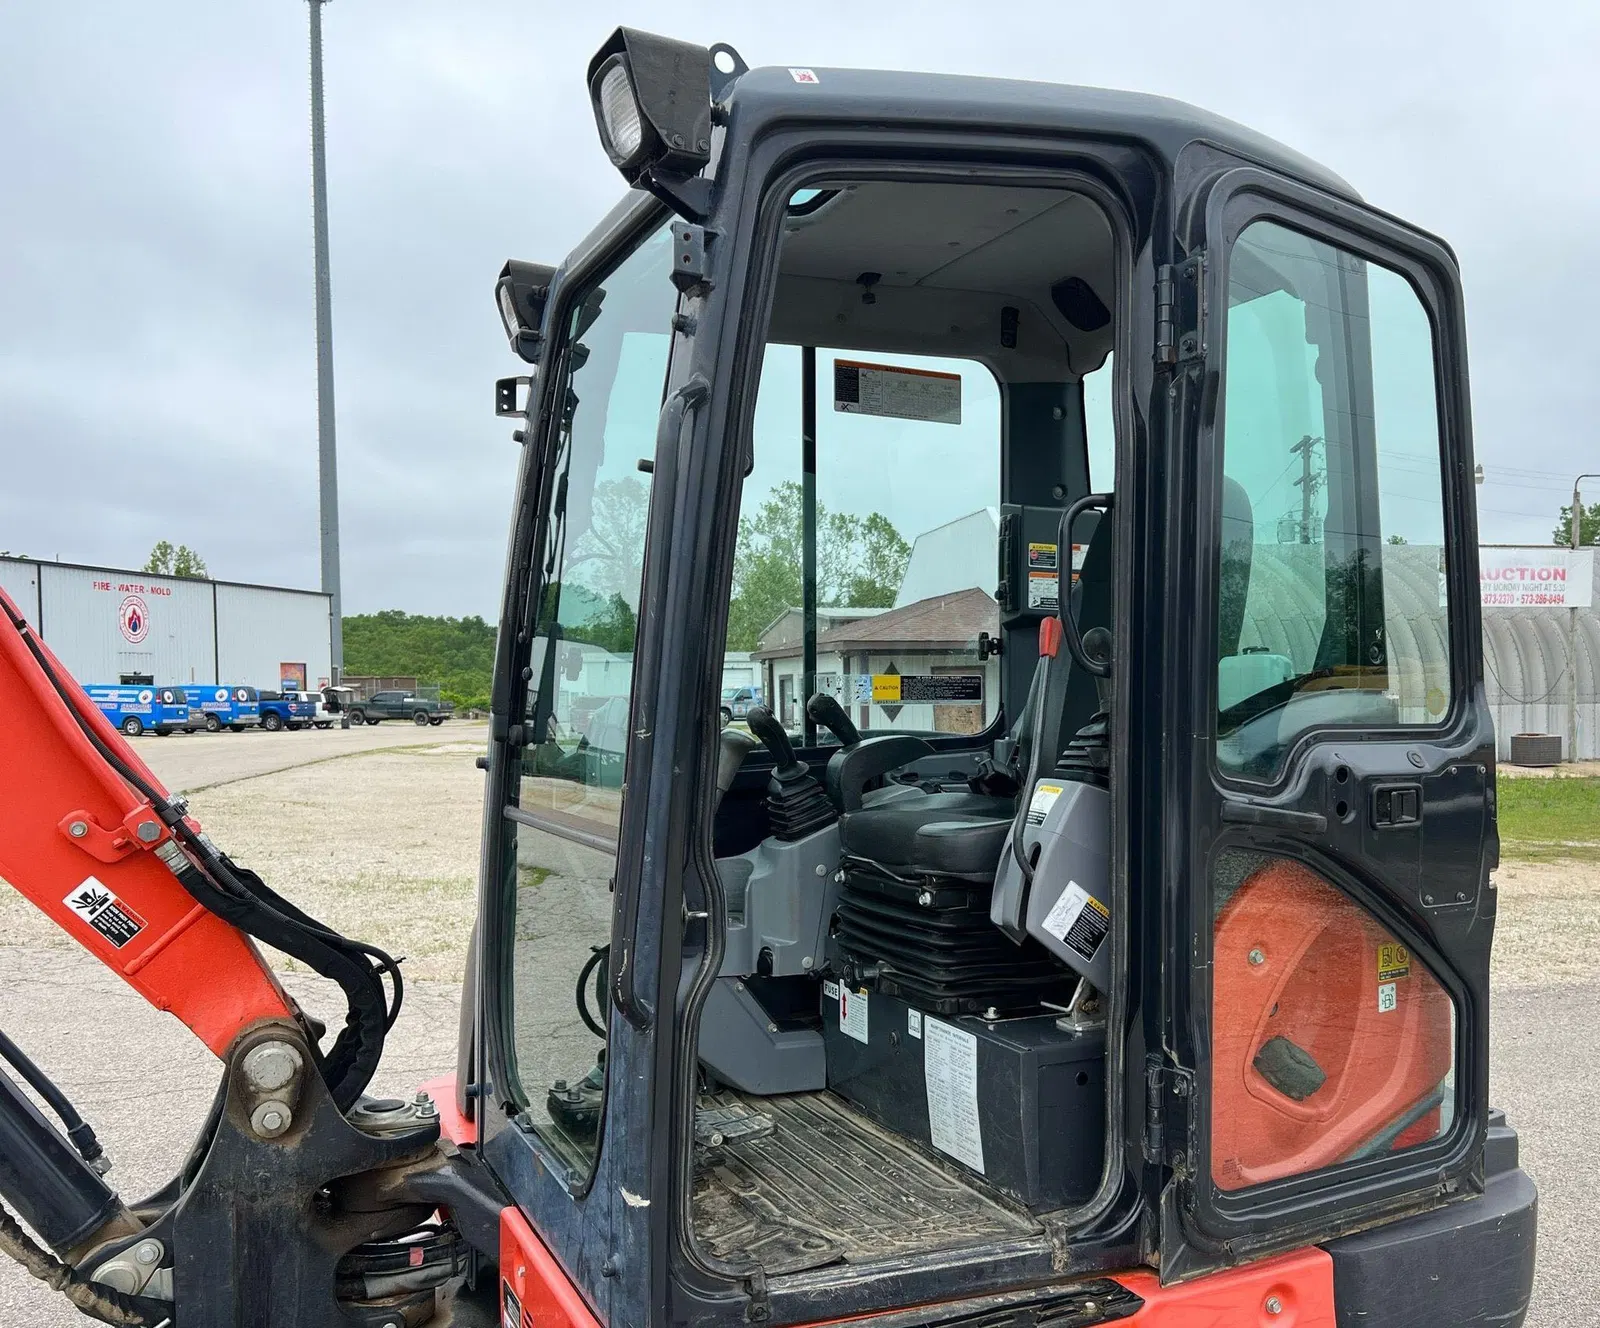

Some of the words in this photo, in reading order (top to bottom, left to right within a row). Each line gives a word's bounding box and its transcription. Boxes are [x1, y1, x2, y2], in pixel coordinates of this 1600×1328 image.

[93, 581, 111, 591] FIRE
[118, 584, 144, 594] WATER
[150, 586, 171, 596] MOLD
[1493, 583, 1520, 592] MONDAY
[1522, 583, 1543, 592] NIGHT
[1543, 583, 1553, 592] AT
[1553, 583, 1566, 592] 5:30
[1521, 594, 1565, 604] 573-286-8494
[121, 906, 144, 924] WARNING
[824, 984, 838, 996] FUSE
